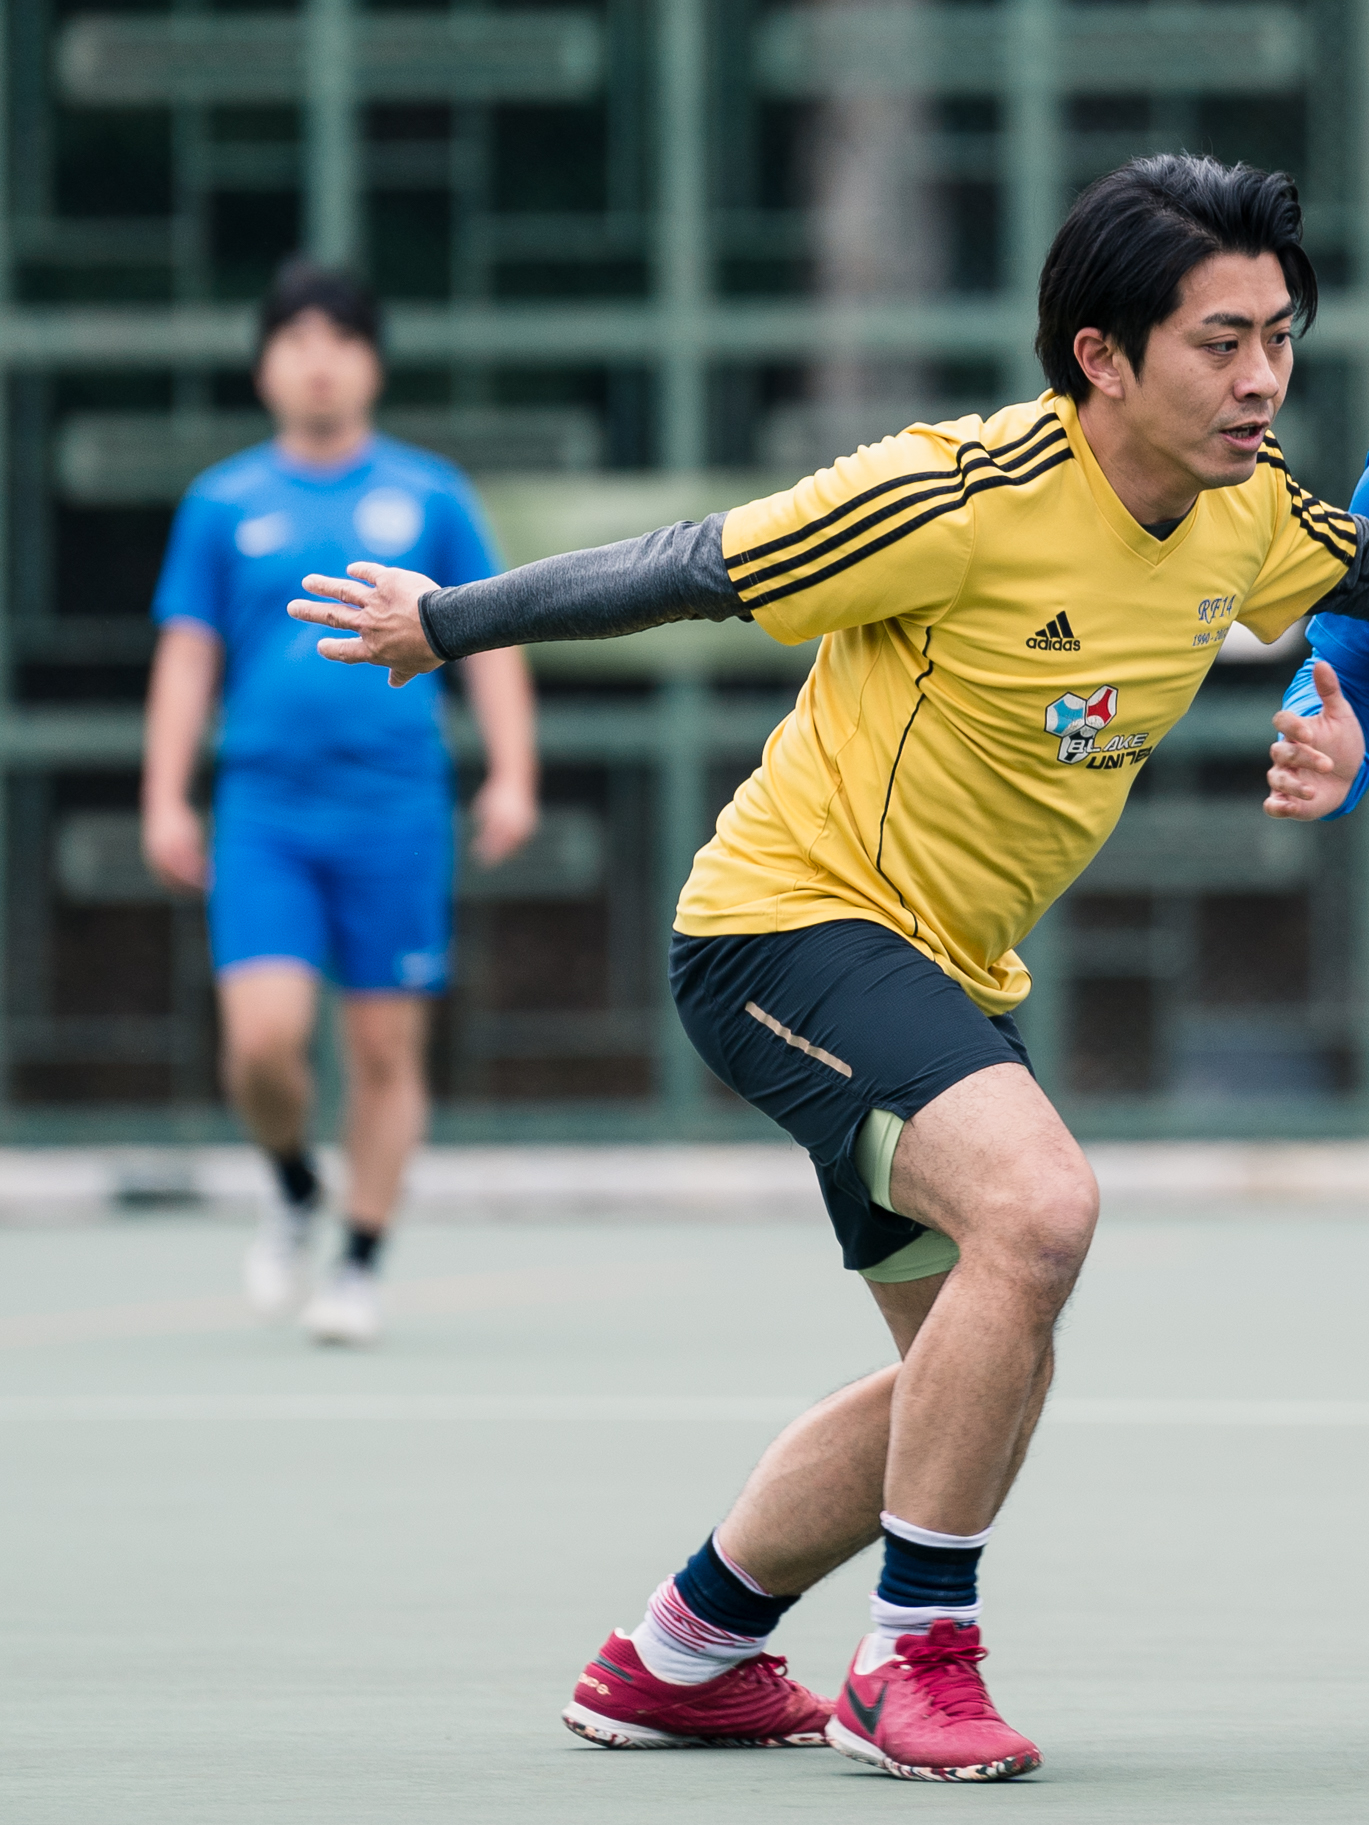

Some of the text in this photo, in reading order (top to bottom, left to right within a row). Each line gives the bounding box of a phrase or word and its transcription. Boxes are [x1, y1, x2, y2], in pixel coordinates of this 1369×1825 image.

[1198, 594, 1237, 624] RF14
[1025, 636, 1081, 651] adidas
[1067, 733, 1149, 754] BLAKE
